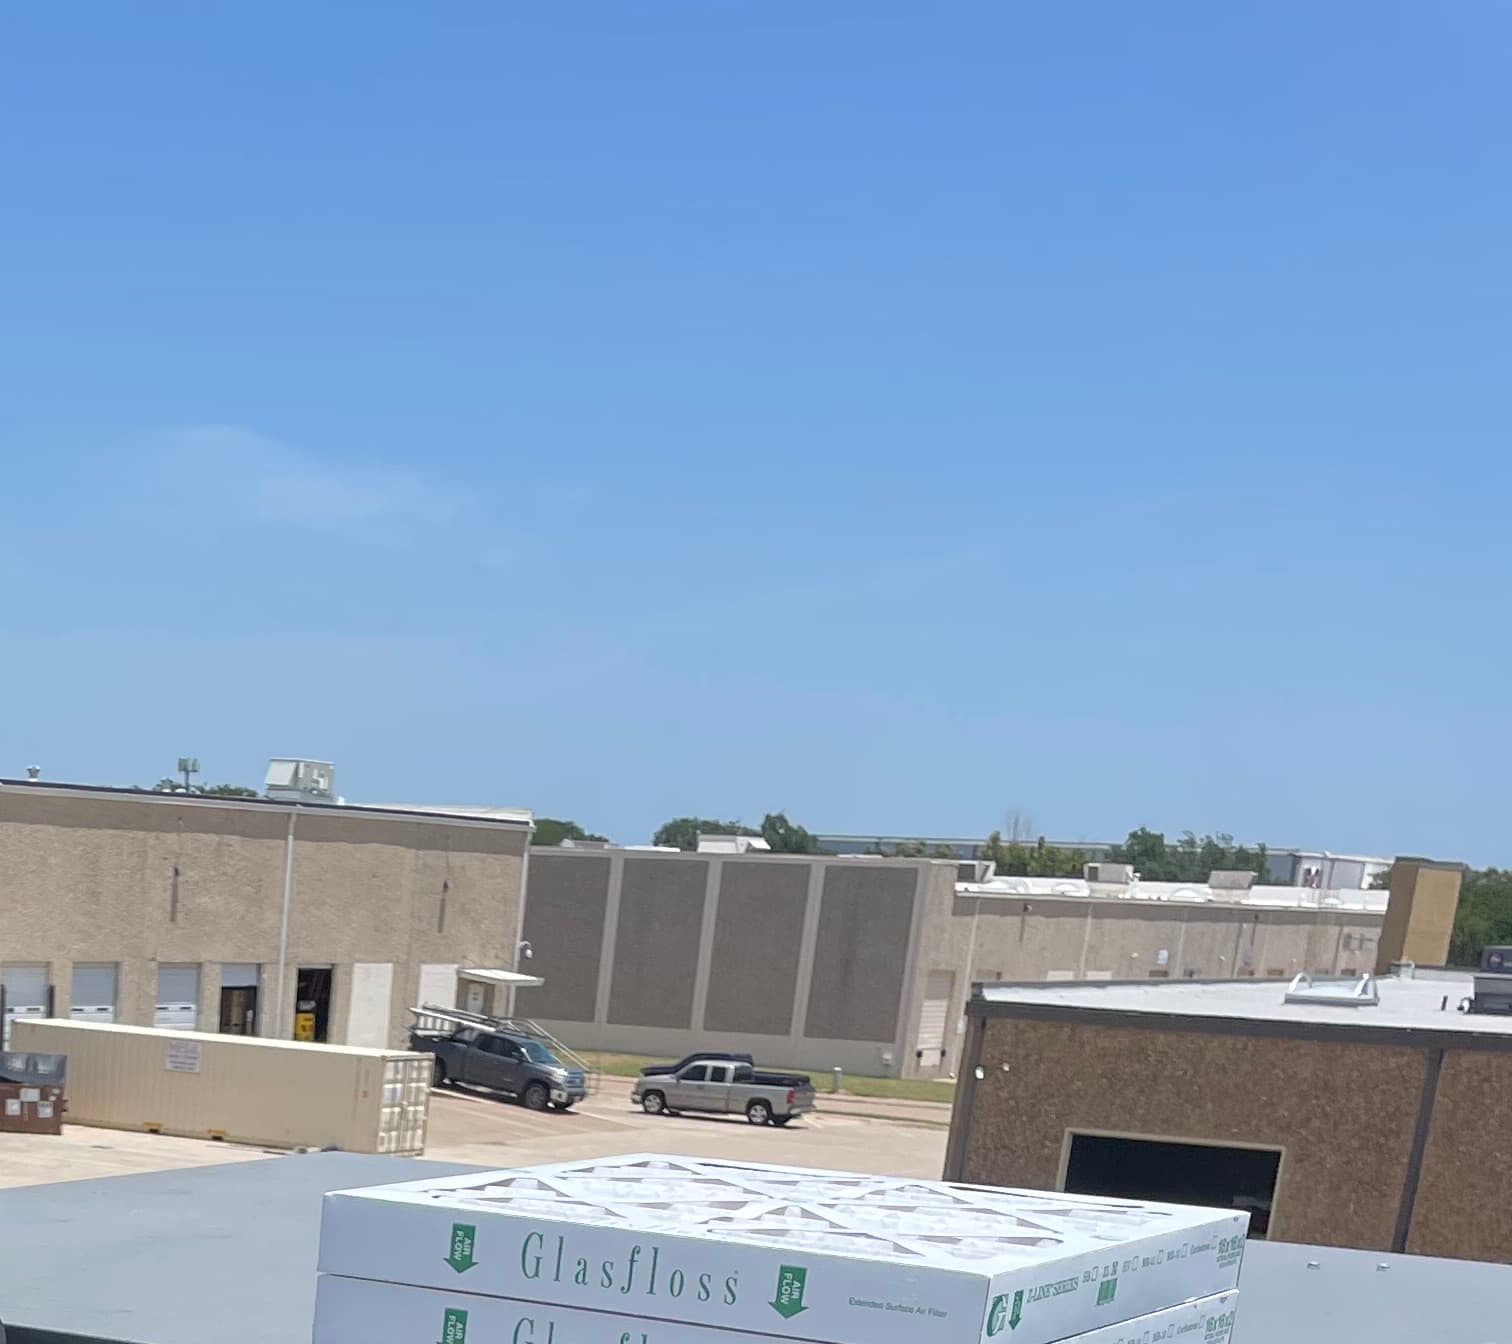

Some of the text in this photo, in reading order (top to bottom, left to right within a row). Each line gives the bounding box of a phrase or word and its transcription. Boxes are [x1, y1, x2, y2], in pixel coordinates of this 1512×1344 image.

[453, 1230, 465, 1261] FLOW
[462, 1236, 471, 1256] AIR
[520, 1231, 739, 1306] Glasfloss
[780, 1272, 792, 1305] FLOW
[791, 1281, 801, 1299] AIR
[446, 1315, 456, 1344] FLOW
[454, 1321, 464, 1340] AIR
